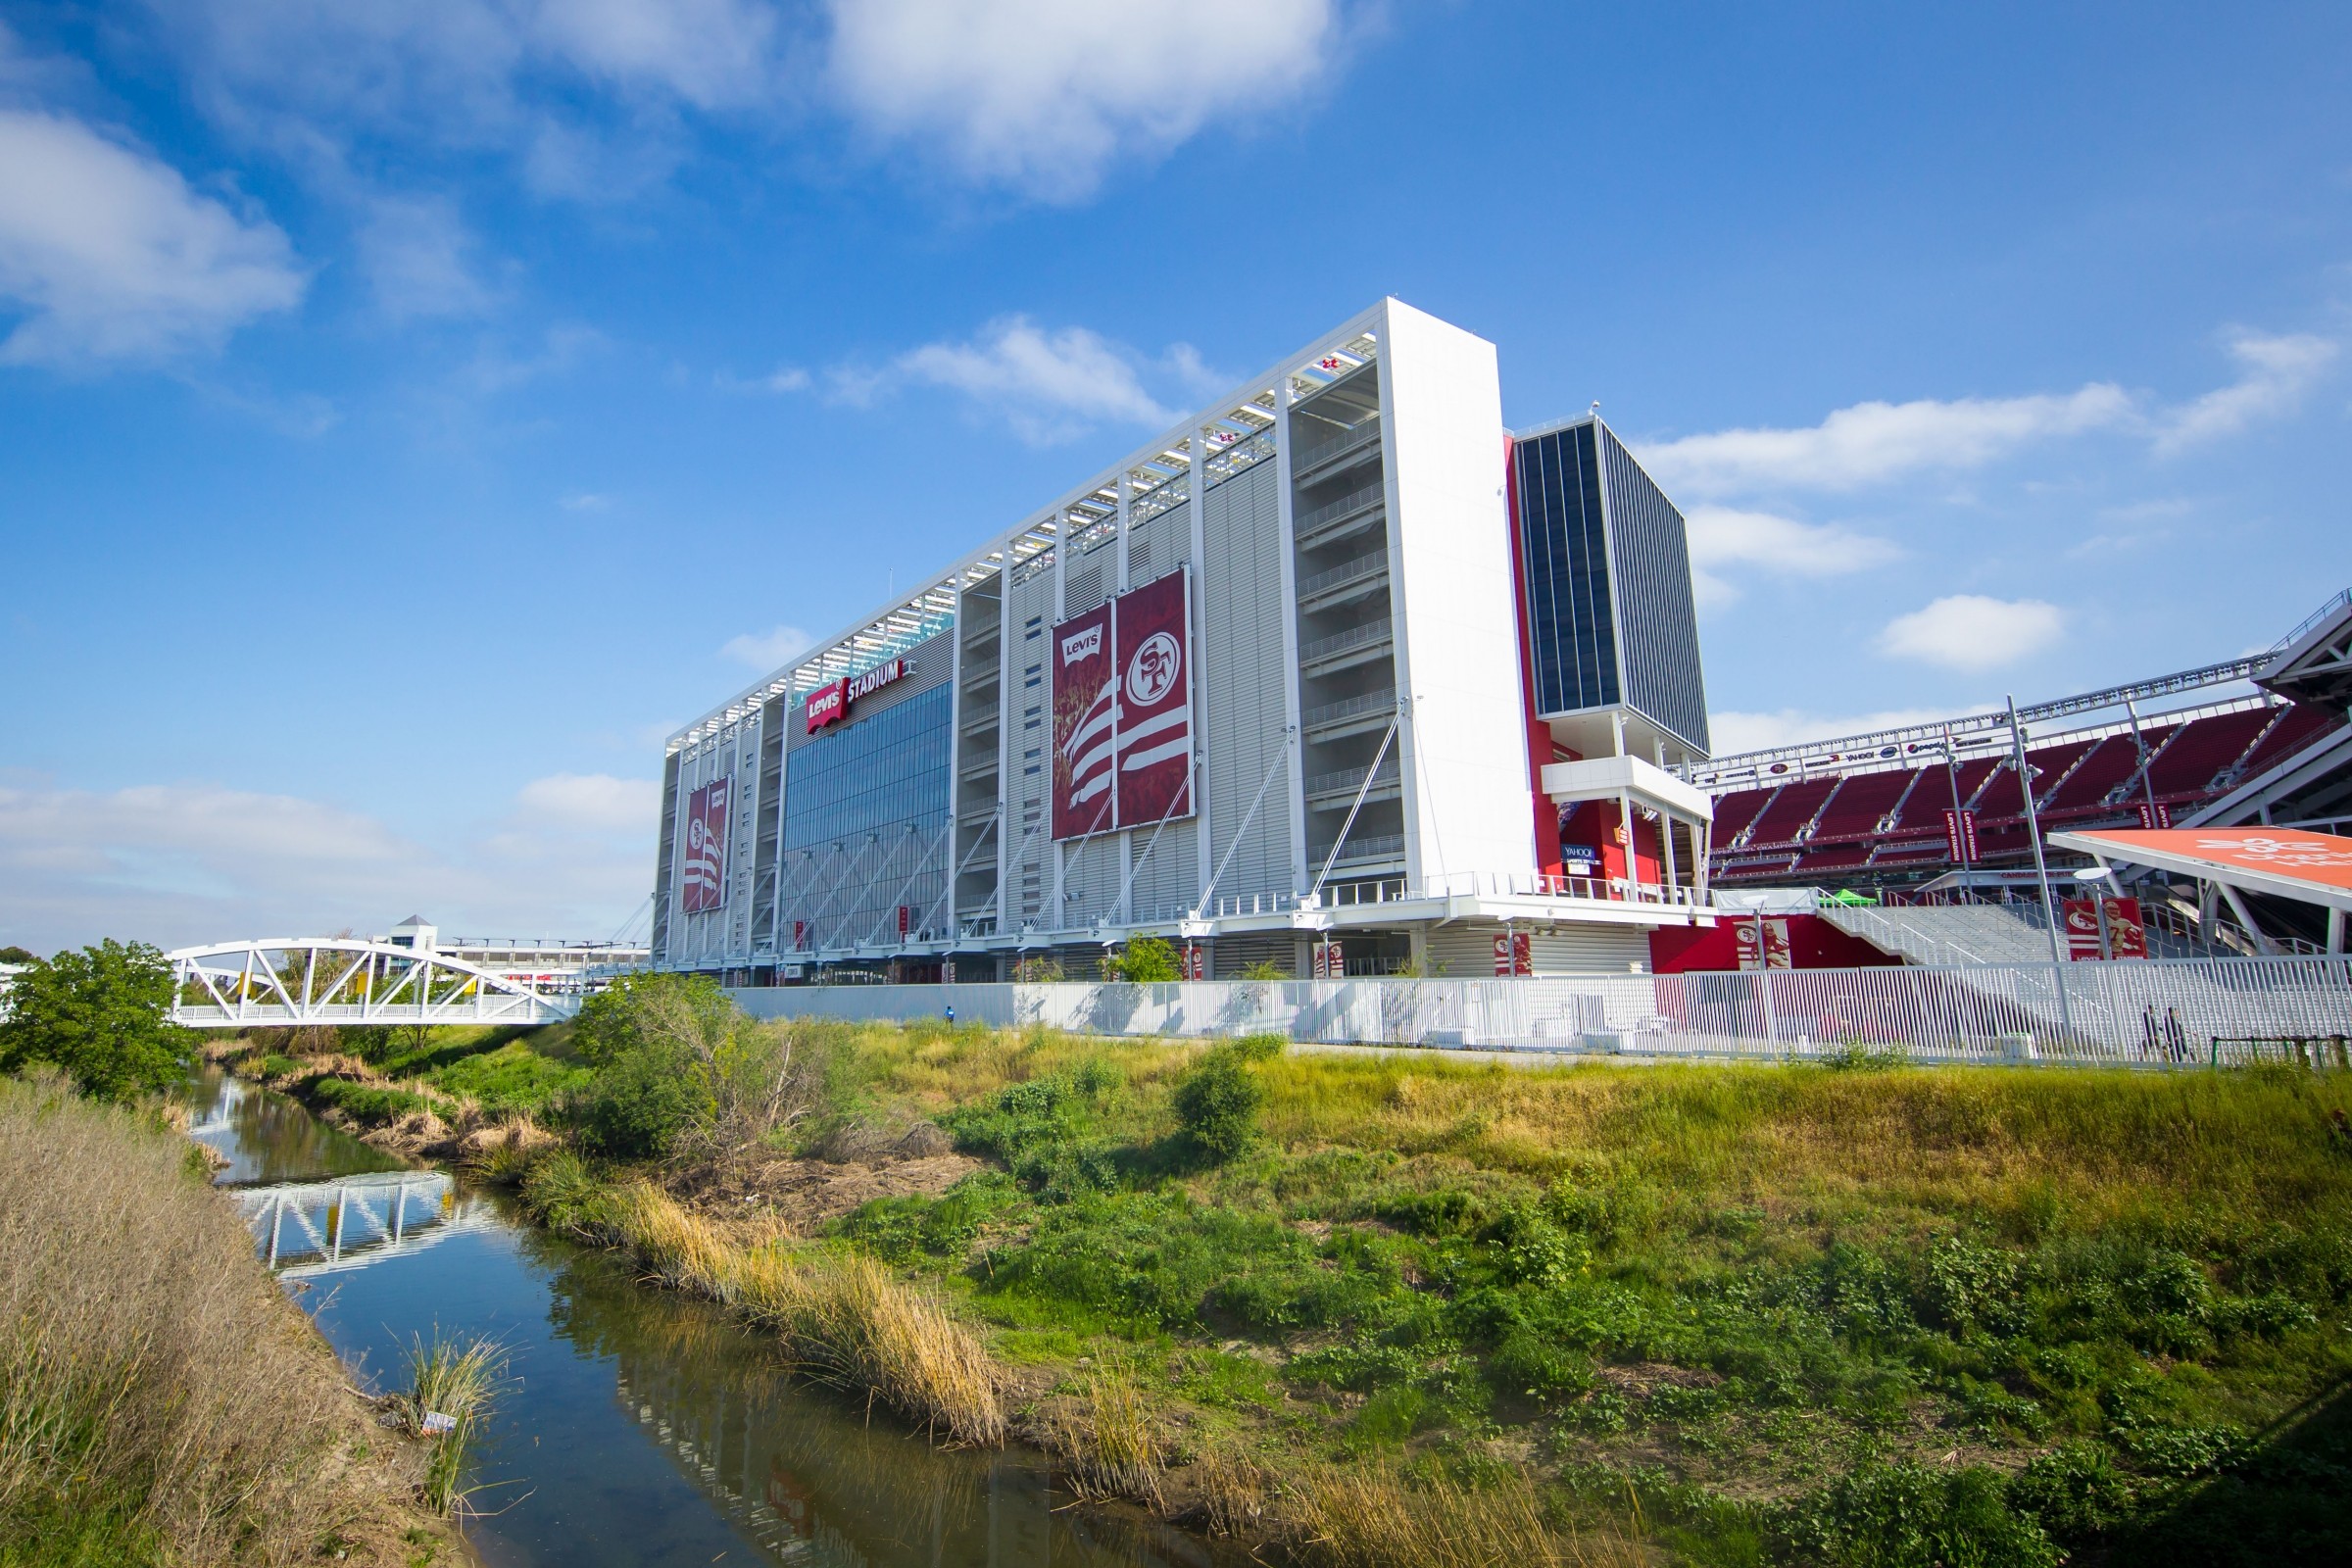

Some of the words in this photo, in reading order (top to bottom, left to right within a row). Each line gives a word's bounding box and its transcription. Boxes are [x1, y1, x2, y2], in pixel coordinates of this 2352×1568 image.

[848, 659, 899, 703] STADIUM
[1845, 751, 1875, 762] YAHOO!
[1565, 847, 1592, 858] YAHOO!
[1756, 842, 1804, 852] CHAMPIONS
[1950, 835, 1960, 861] STADIUM
[1968, 834, 1978, 860] STADIUM
